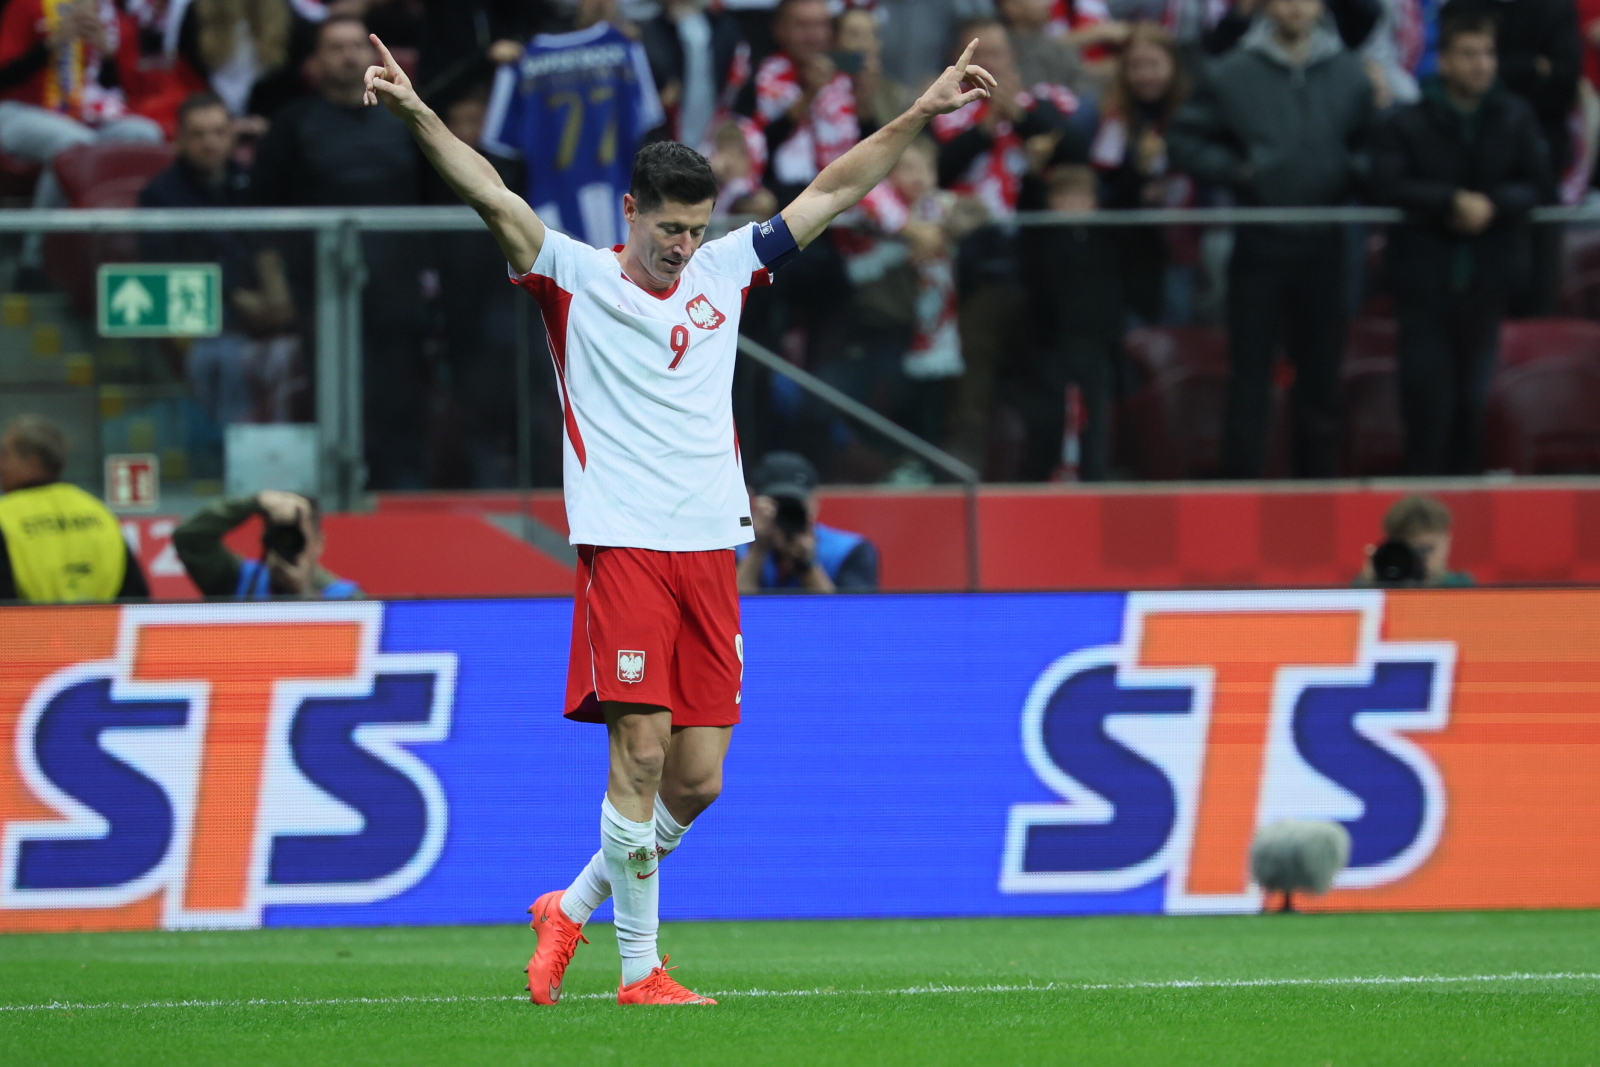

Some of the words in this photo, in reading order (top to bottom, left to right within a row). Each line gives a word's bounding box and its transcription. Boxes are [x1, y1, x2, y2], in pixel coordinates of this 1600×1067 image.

[667, 325, 690, 371] 9
[9, 616, 442, 914] STS
[1010, 608, 1436, 898] STS
